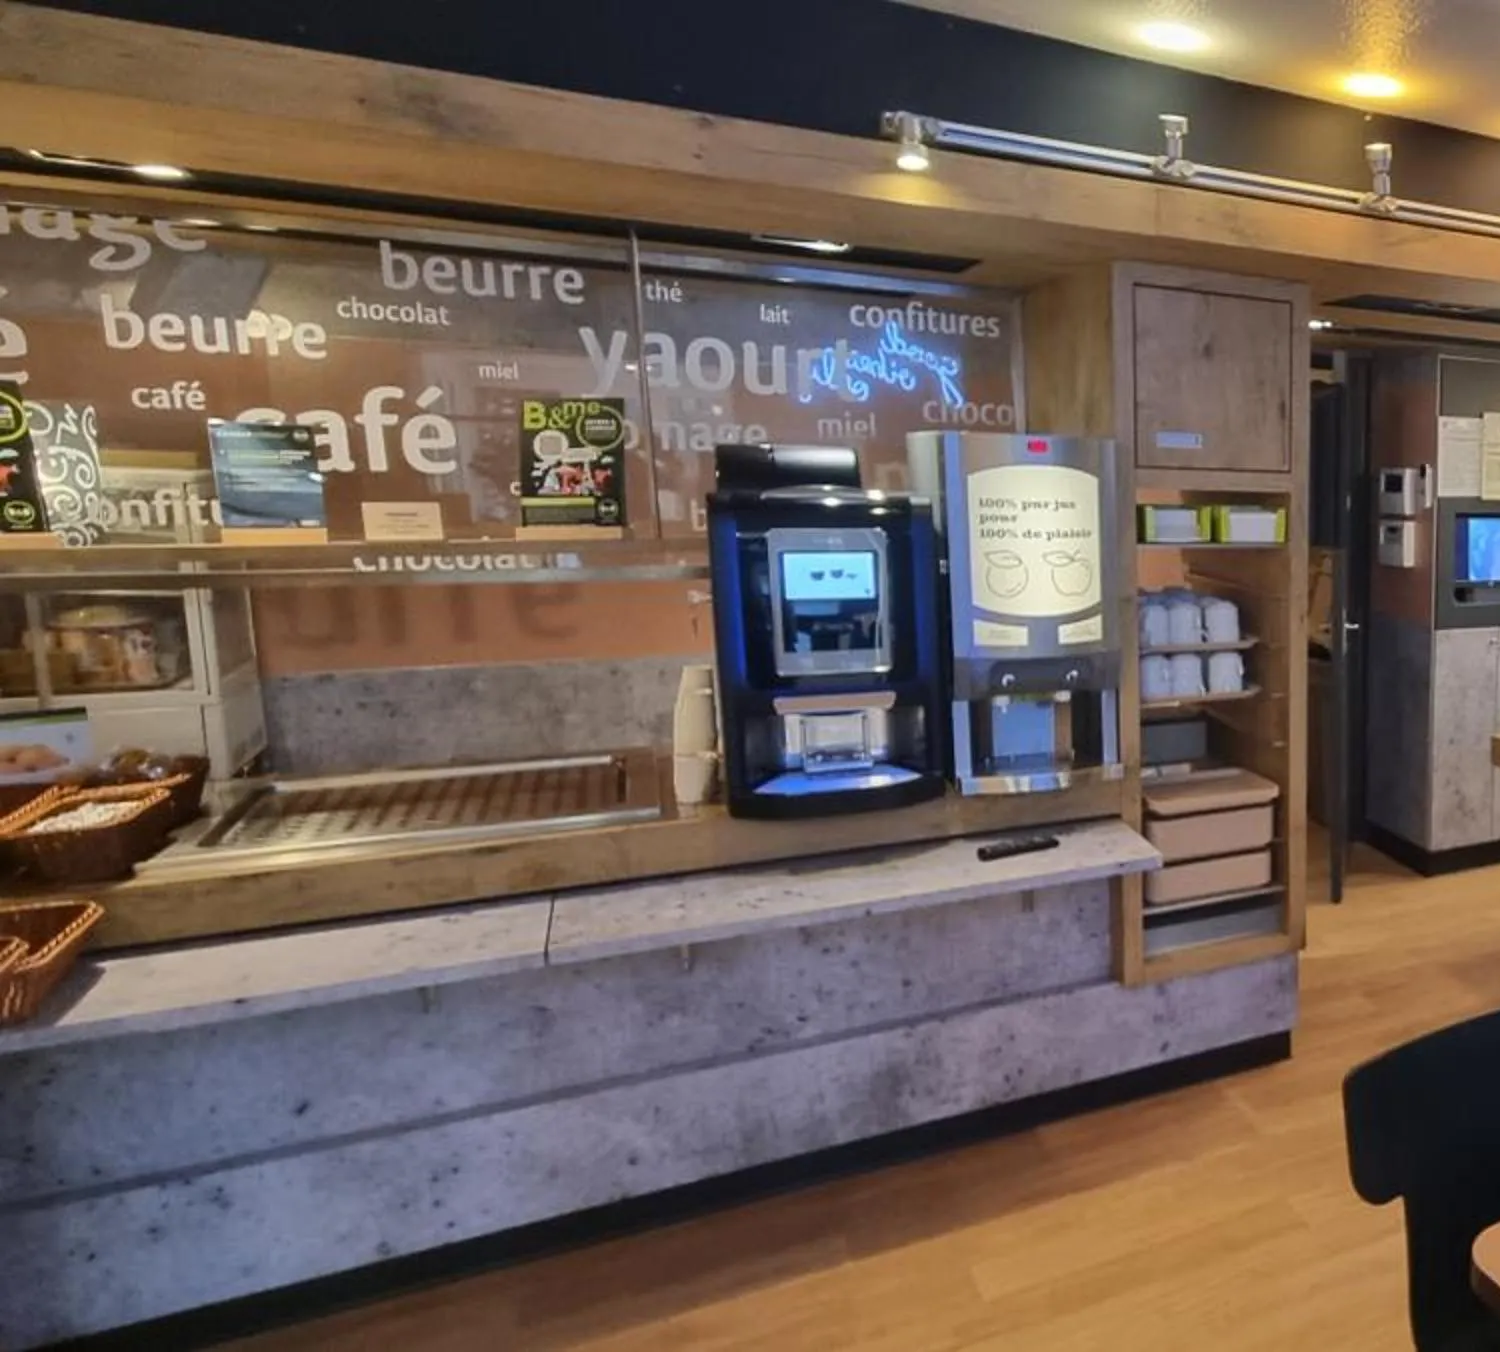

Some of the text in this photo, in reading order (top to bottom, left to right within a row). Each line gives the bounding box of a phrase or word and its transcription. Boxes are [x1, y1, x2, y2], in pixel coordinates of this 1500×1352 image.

[379, 240, 585, 304] beurre
[645, 282, 683, 303] thé
[101, 294, 327, 359] beurre
[336, 296, 451, 326] chocolat
[760, 304, 790, 325] lait
[849, 301, 1000, 338] confitures
[478, 362, 519, 380] miel
[578, 326, 861, 402] yaourt
[132, 380, 206, 411] café
[235, 386, 458, 474] afé
[817, 412, 876, 439] miel
